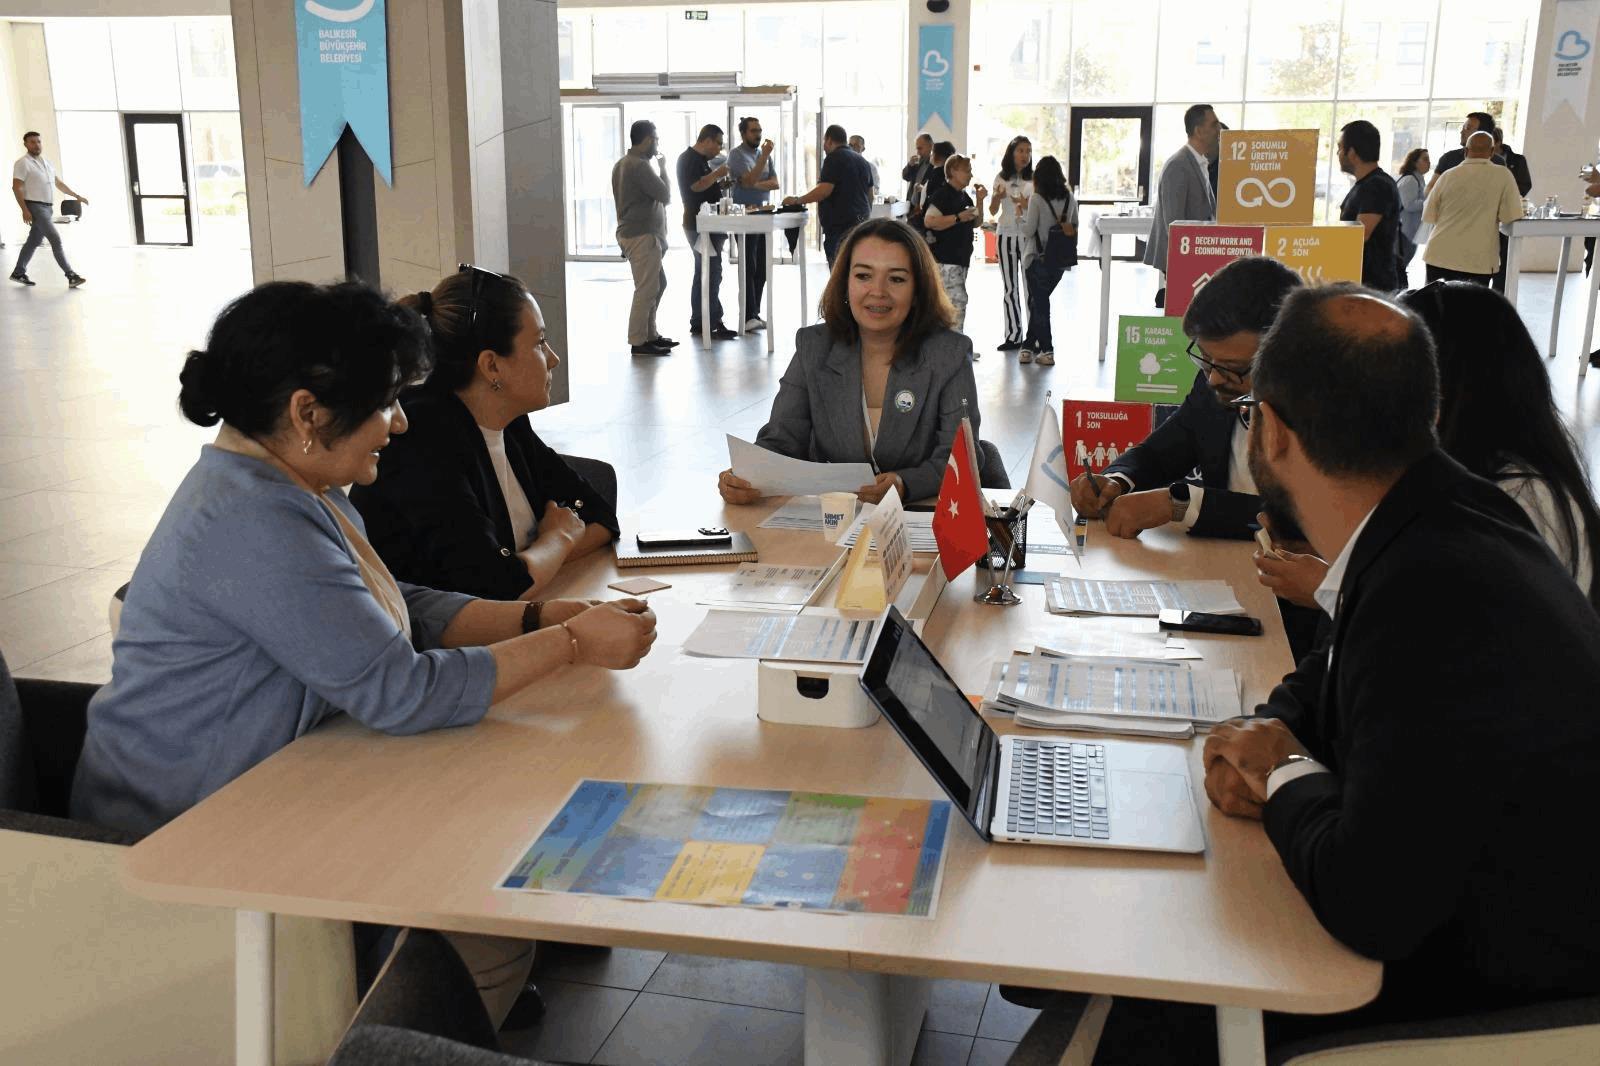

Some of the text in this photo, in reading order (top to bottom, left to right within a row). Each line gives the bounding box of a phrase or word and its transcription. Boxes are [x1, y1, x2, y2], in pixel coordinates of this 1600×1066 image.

[320, 39, 367, 53] BÜYÜKŞEHİR
[1231, 141, 1246, 160] 12
[1251, 141, 1287, 150] SORUMLU
[1251, 150, 1289, 160] ÜRETİM VE
[1250, 161, 1281, 171] TÜKETİM
[1180, 236, 1190, 255] 8
[1195, 236, 1253, 246] DECENT WORK AND
[1194, 247, 1226, 256] ECONOMIC
[1277, 237, 1287, 256] 2
[1292, 248, 1309, 256] SON
[1125, 326, 1140, 343] 15
[1144, 327, 1174, 336] KARASAL
[1075, 410, 1082, 428] 1
[1087, 410, 1128, 420] YOKSULLUĞA
[1086, 421, 1101, 429] SON
